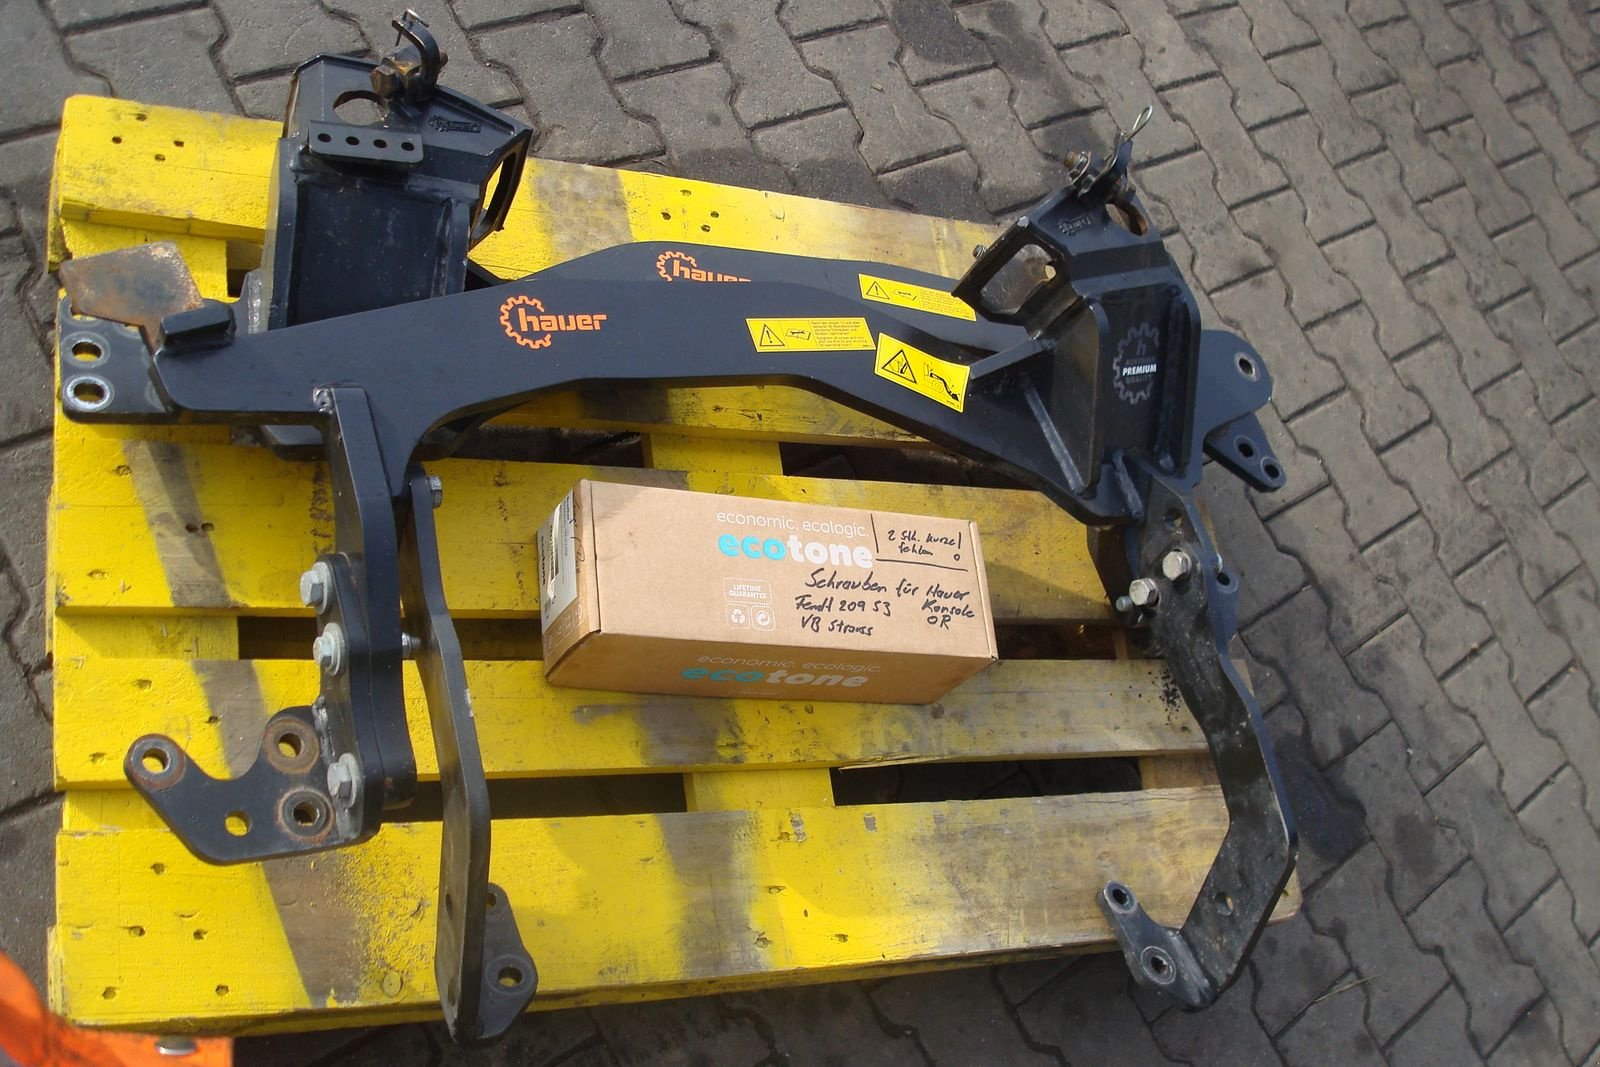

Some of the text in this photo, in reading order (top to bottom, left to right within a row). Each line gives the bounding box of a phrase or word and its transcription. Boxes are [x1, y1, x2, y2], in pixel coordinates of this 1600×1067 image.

[518, 307, 607, 332] hauer
[1122, 363, 1157, 377] PREMIUM
[716, 511, 870, 539] economic. ecologic.
[887, 529, 896, 541] 2
[718, 533, 873, 569] ecotone
[805, 567, 970, 601] Schrauben für Hauer
[838, 599, 866, 612] 209
[921, 598, 975, 618] Konsole
[680, 666, 869, 688] ecotone
